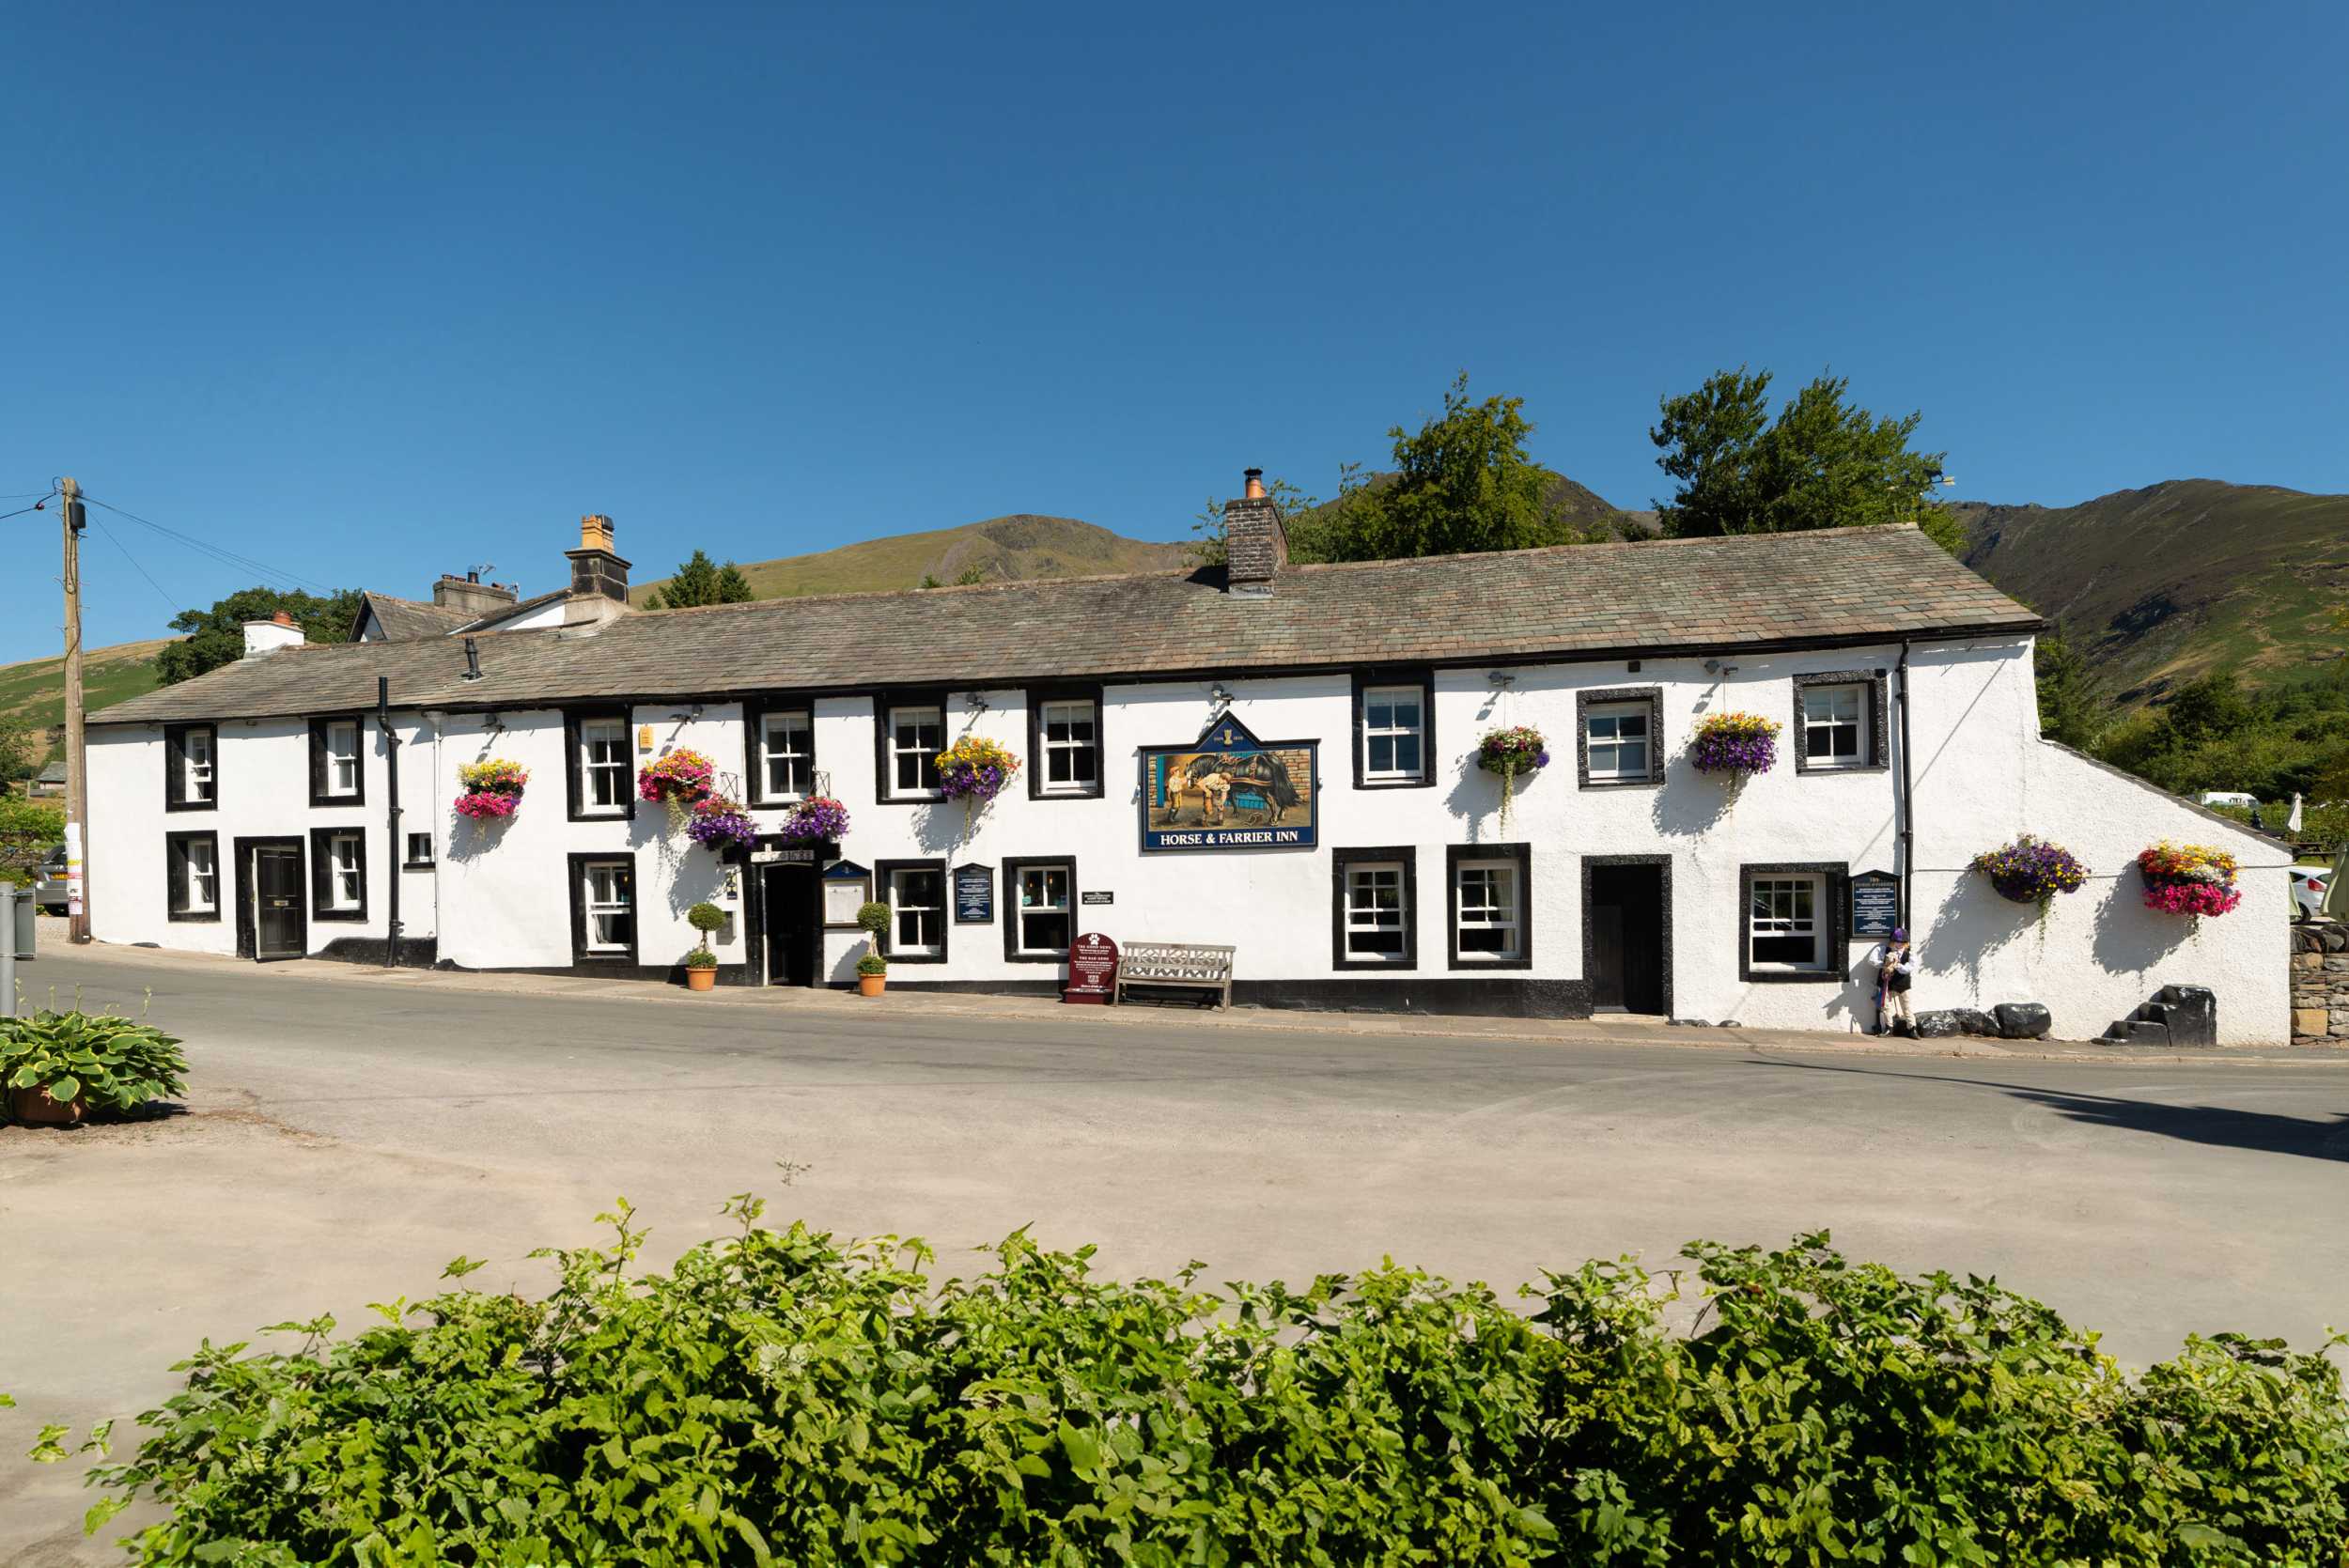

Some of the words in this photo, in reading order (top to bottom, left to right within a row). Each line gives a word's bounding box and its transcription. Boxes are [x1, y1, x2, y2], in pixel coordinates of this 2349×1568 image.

[1160, 834, 1202, 846] HORSE
[1206, 833, 1215, 844] &
[1219, 831, 1273, 844] FARRIER
[1276, 831, 1299, 842] INN
